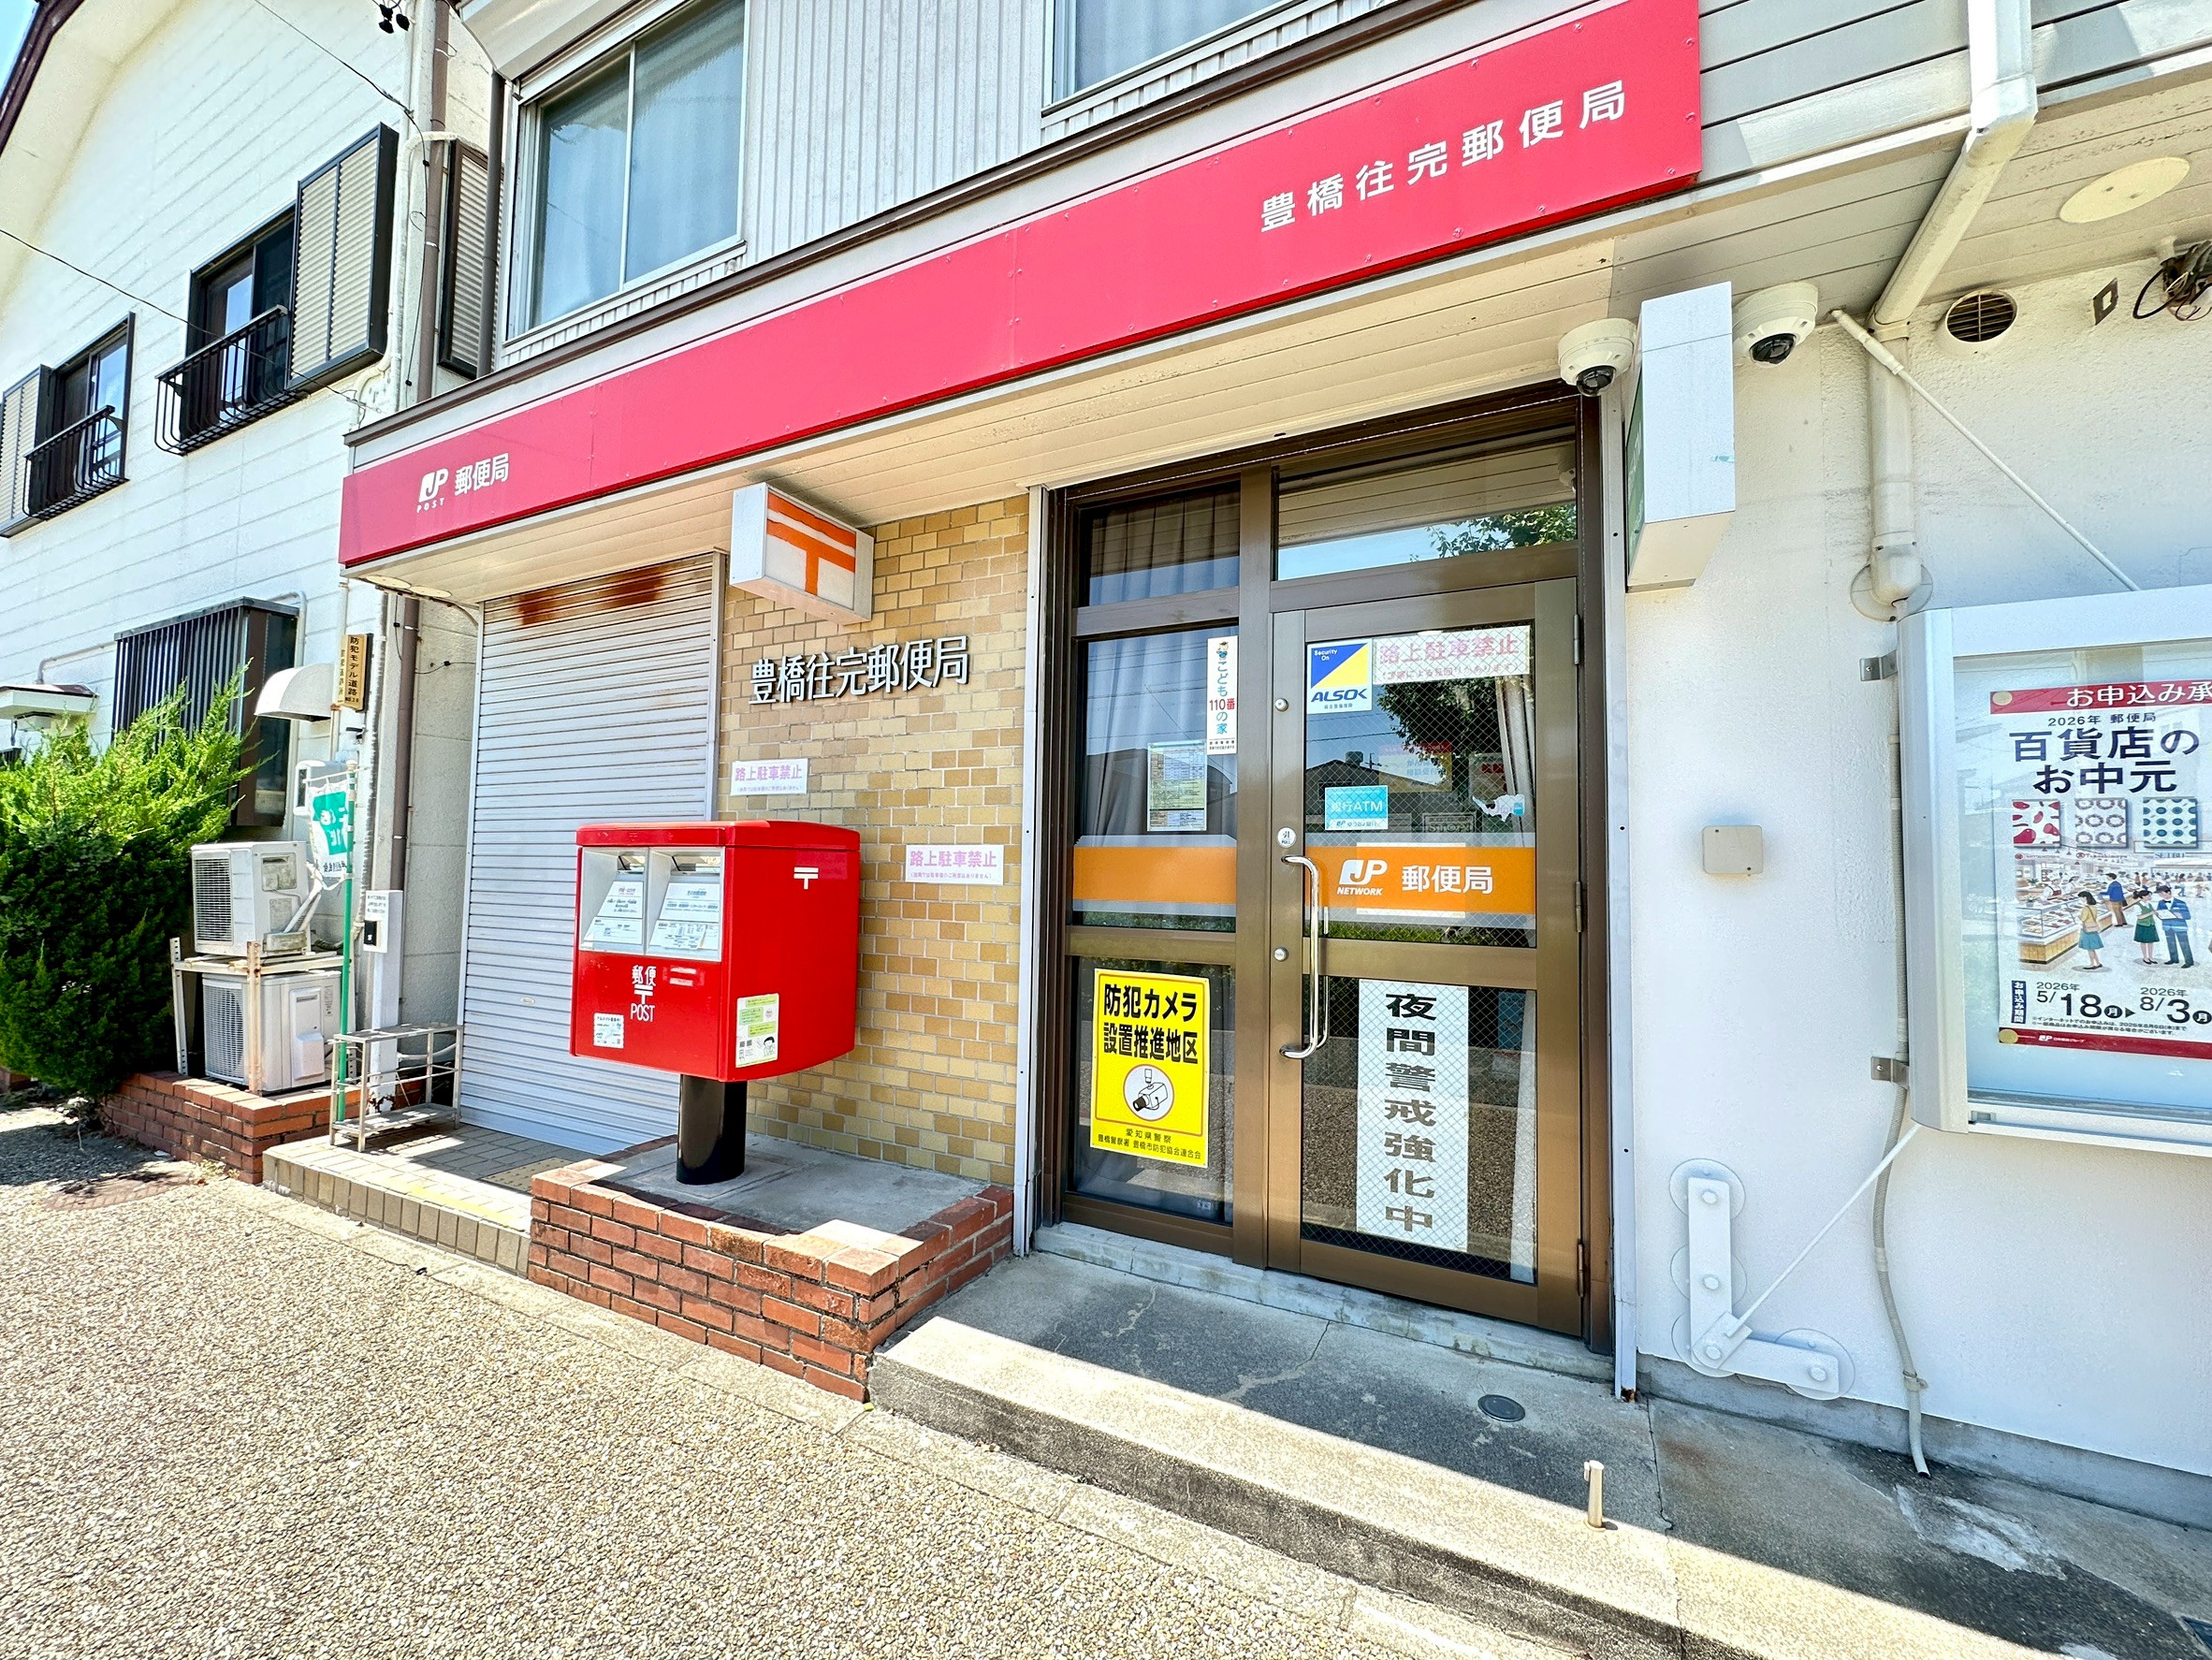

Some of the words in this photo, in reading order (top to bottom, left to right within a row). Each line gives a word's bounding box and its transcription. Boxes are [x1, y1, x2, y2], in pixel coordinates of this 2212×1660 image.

[1260, 80, 1624, 232] 豊橋往完郵便局
[418, 468, 448, 502] JP
[455, 452, 509, 496] 郵便局
[416, 498, 444, 513] POST
[1379, 633, 1520, 664] 路上駐車禁止
[348, 636, 360, 696] 防犯モデル道路
[749, 635, 968, 705] 豊橋往完郵便局
[1310, 689, 1368, 703] ALSOK
[2067, 681, 2212, 707] お申込み承
[2047, 714, 2102, 727] 2026年
[2110, 712, 2157, 724] 郵便局
[2009, 726, 2200, 763] 百貨店の
[735, 764, 803, 781] 路上駐車禁止
[2032, 760, 2177, 794] お中元
[910, 850, 997, 868] 路上駐車禁止
[1336, 886, 1384, 896] NETWORK
[1338, 859, 1388, 886] JP
[1401, 865, 1494, 895] 郵便局
[632, 964, 657, 987] 郵便
[2035, 982, 2081, 992] 2026年
[2140, 986, 2189, 997] 2026年
[630, 1002, 656, 1023] POST
[1103, 983, 1198, 1023] 防犯カメラ
[2014, 982, 2025, 1024] お申込み期間
[1103, 1022, 1199, 1065] 設置推進地区
[1383, 993, 1437, 1232] 夜間警戒強化中
[1126, 1128, 1171, 1143] 愛知県警察
